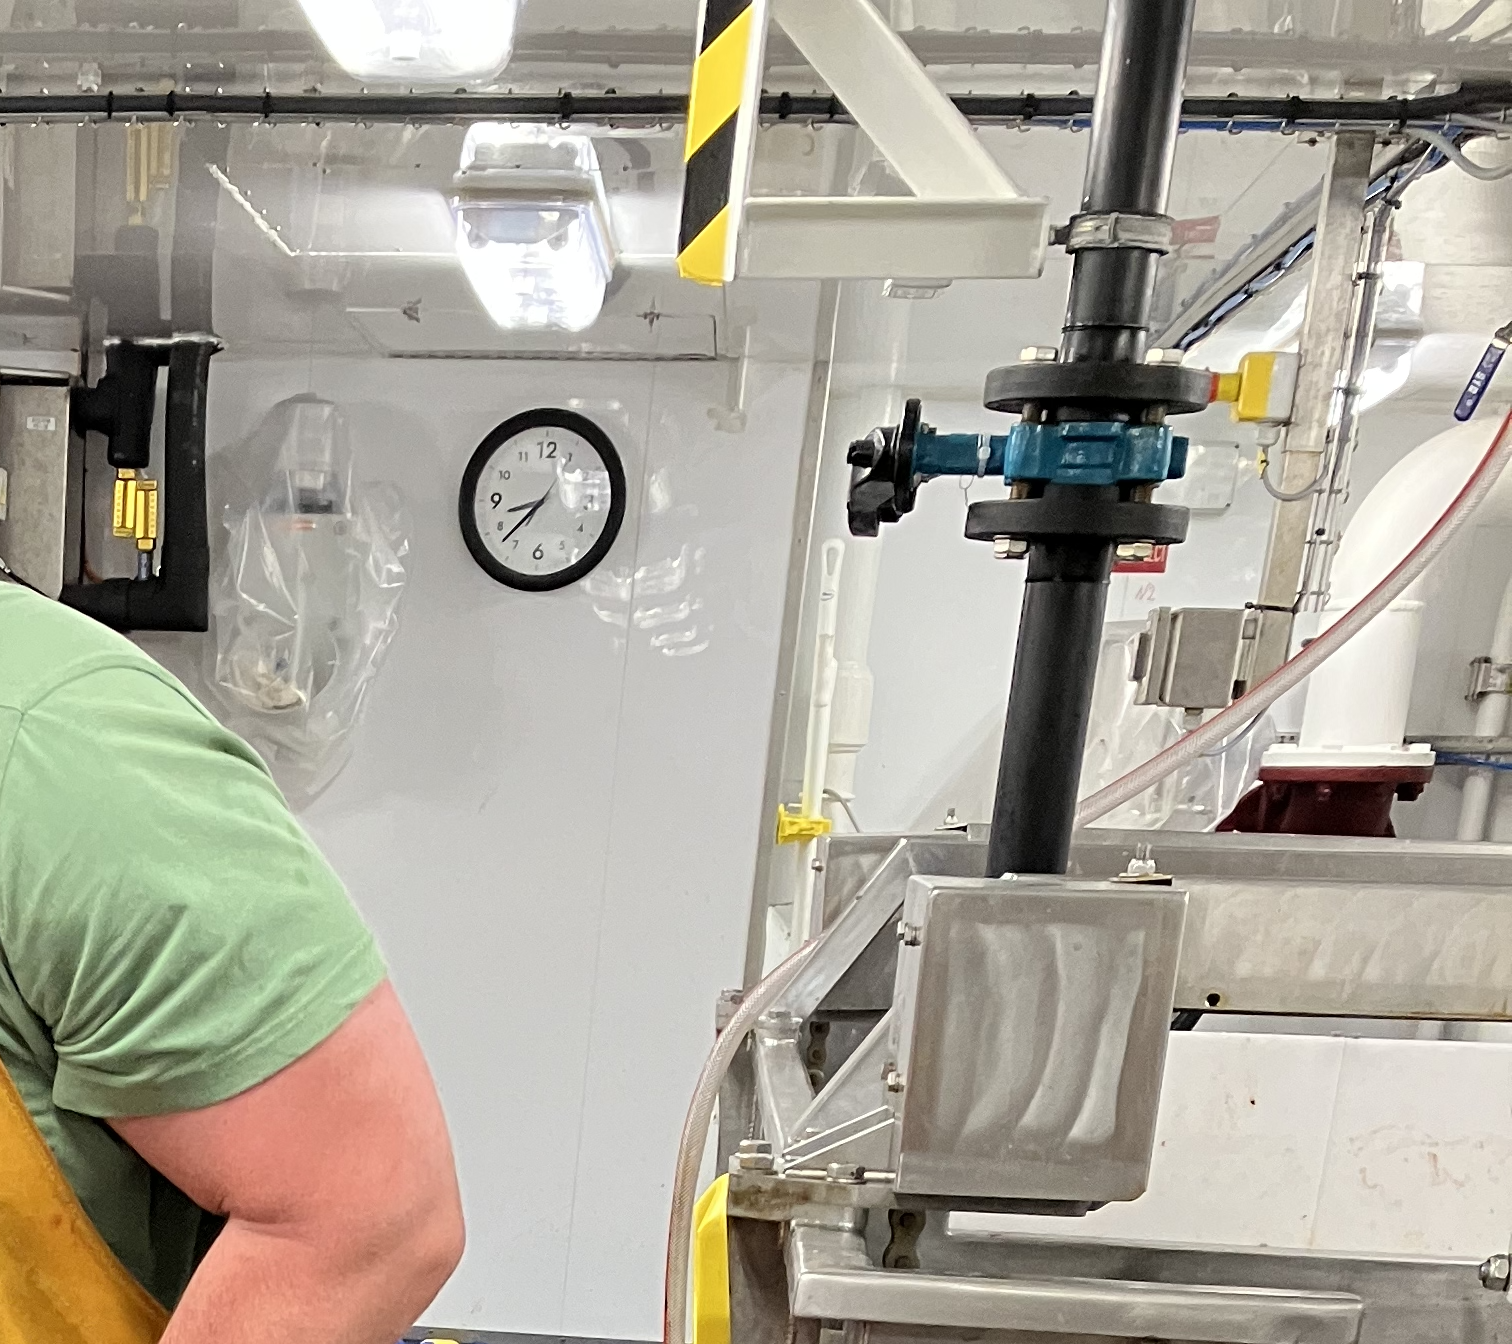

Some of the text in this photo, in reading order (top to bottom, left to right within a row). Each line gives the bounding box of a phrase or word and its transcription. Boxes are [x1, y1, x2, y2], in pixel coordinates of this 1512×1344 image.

[536, 441, 557, 459] 12
[518, 451, 529, 462] 11
[567, 452, 573, 462] 1
[499, 470, 511, 481] 10
[490, 492, 503, 509] 9
[496, 520, 504, 531] 8
[576, 523, 584, 533] 4
[512, 540, 519, 550] 7
[559, 540, 566, 551] 5
[532, 543, 544, 560] 6
